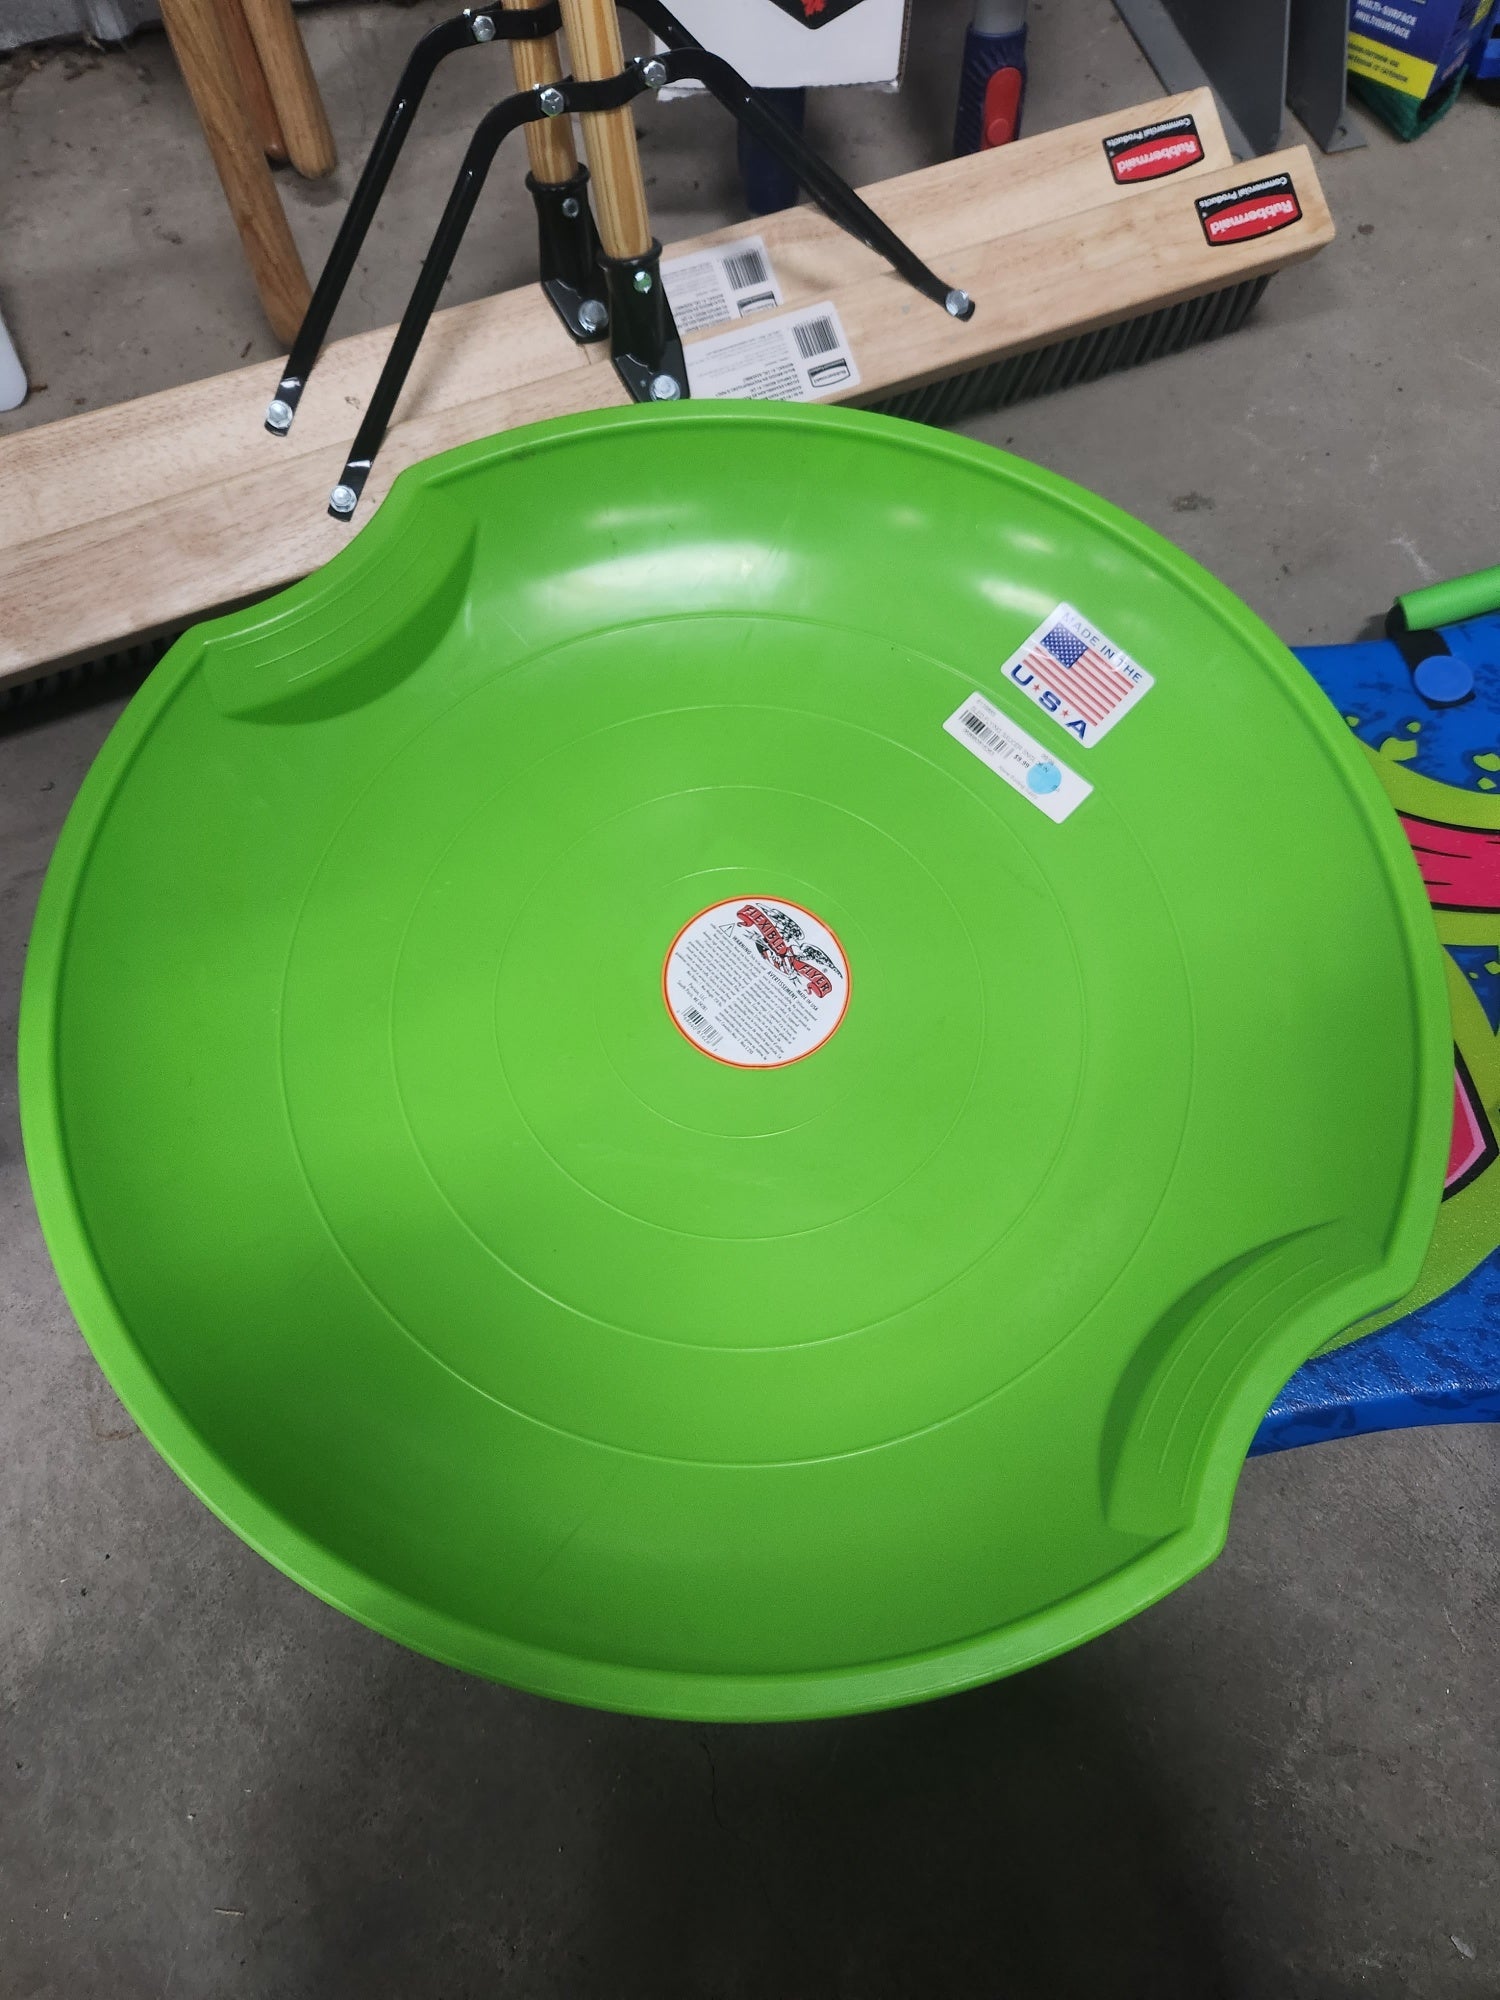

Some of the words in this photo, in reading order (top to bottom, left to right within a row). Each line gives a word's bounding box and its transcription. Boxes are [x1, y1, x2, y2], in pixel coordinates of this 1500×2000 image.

[1106, 129, 1144, 147] Products
[1144, 117, 1191, 137] Commercial
[1116, 140, 1196, 174] Rubbermaid
[1199, 190, 1238, 208] Products
[1237, 176, 1288, 197] Commercial
[1210, 199, 1294, 235] Rubbermaid
[1062, 612, 1100, 647] MADE
[1100, 645, 1115, 660] IN
[1117, 656, 1143, 684] THE
[742, 904, 784, 951] FLEXIBLE
[798, 964, 830, 992] FLYER
